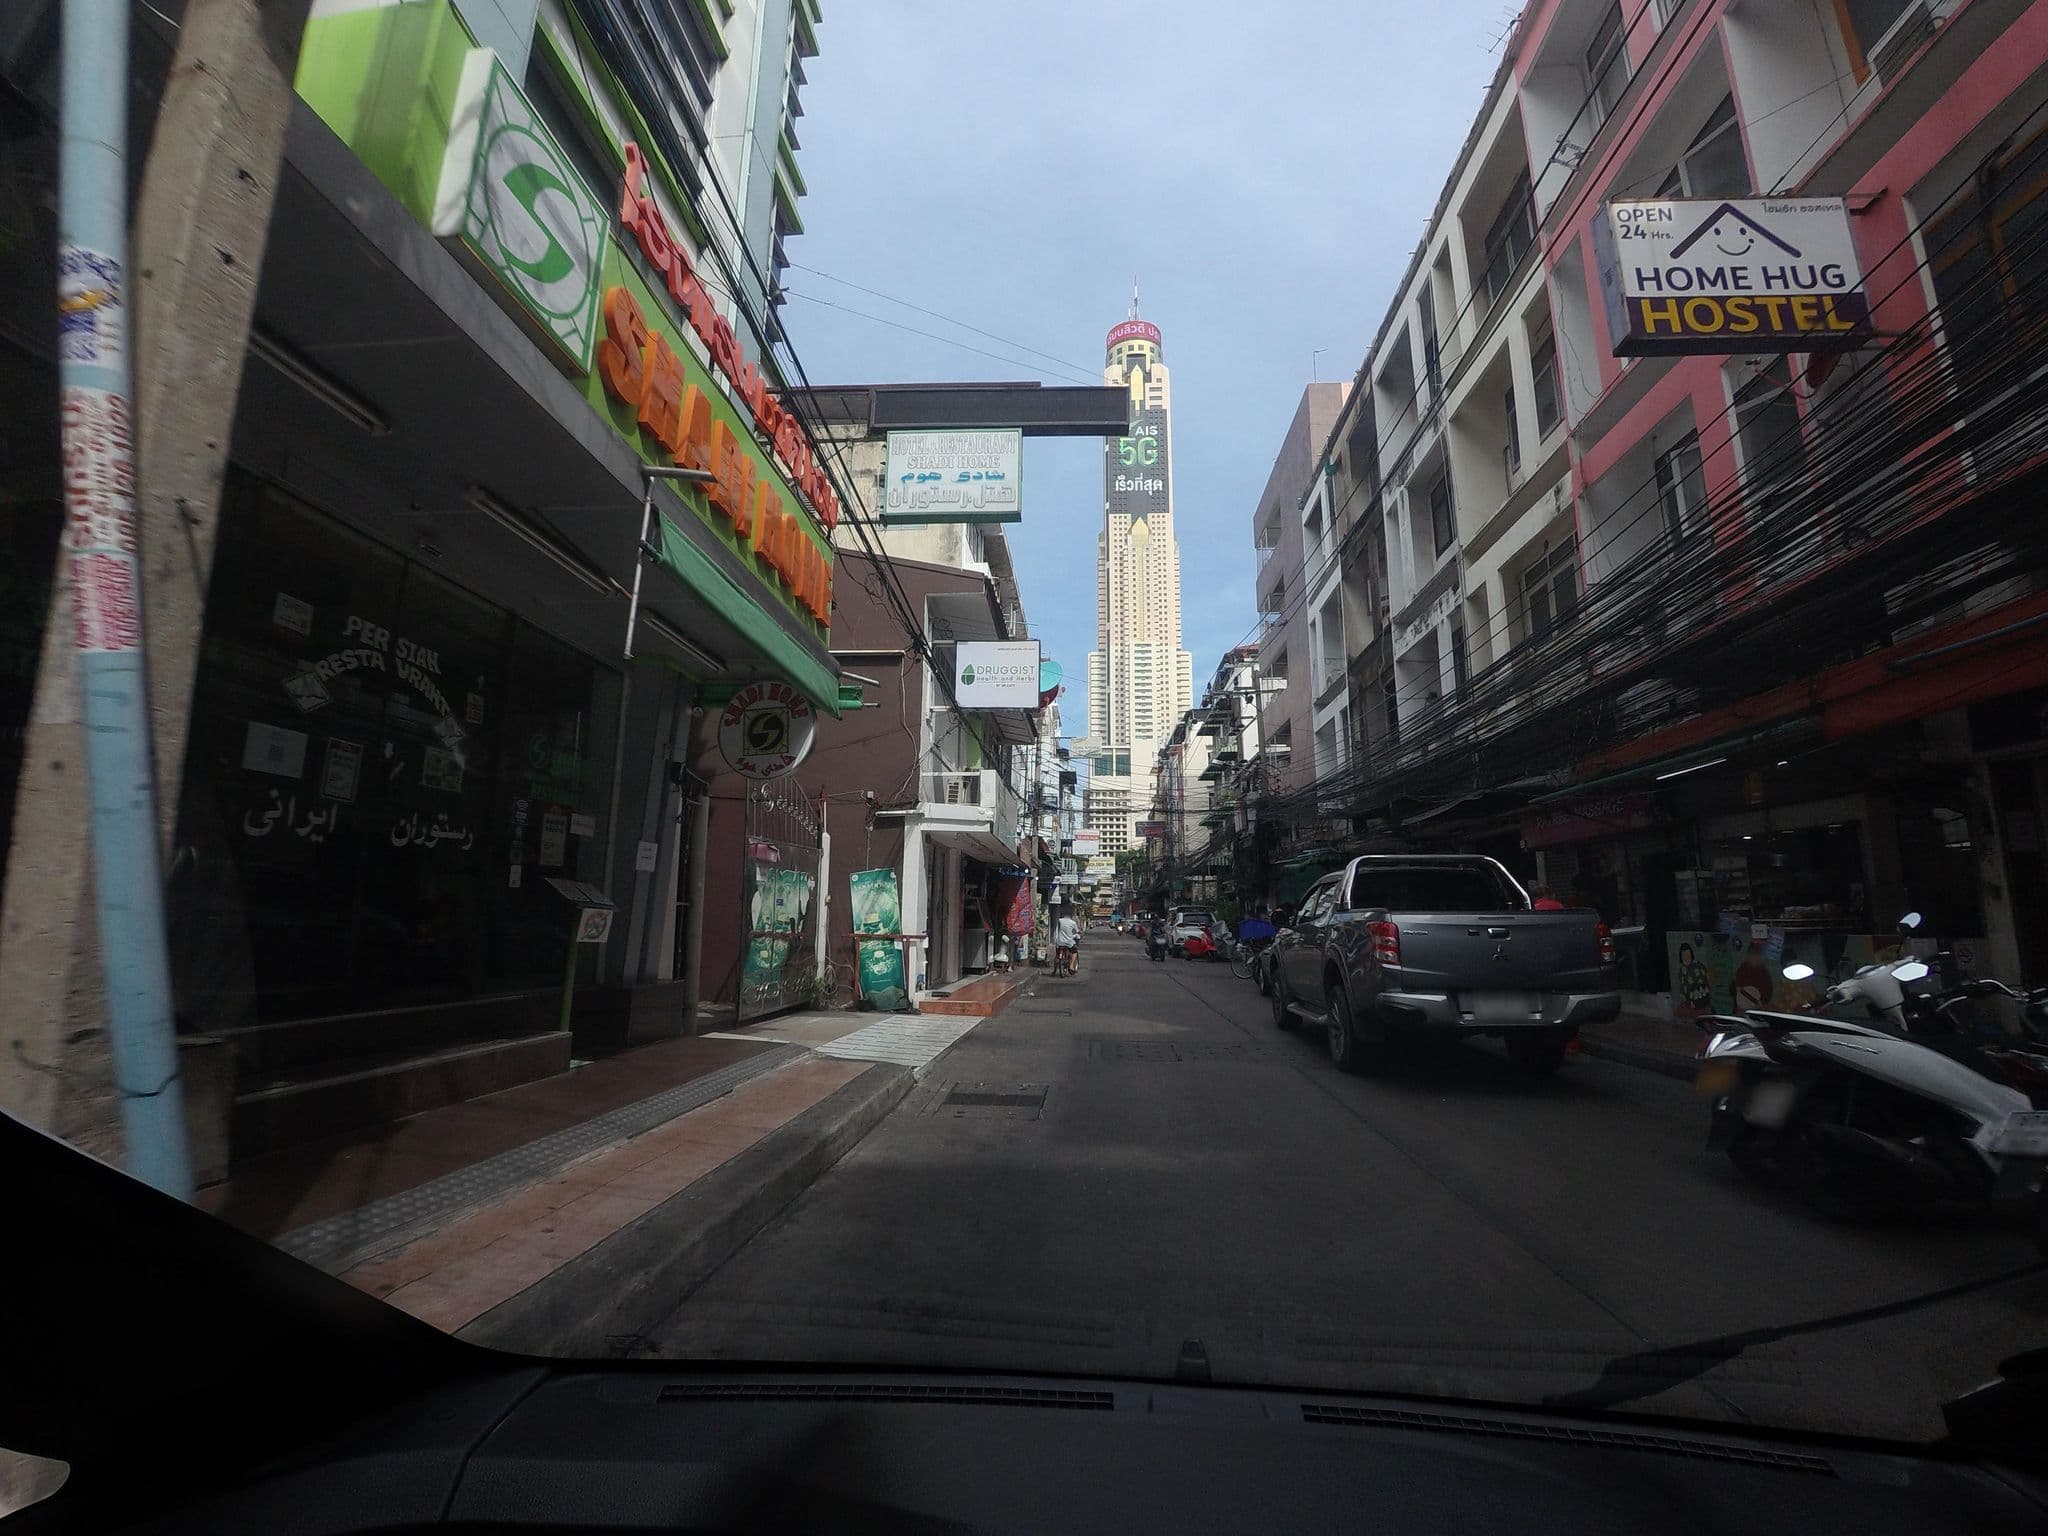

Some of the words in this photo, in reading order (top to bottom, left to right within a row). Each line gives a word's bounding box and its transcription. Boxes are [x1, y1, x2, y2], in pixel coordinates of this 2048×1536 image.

[1616, 207, 1673, 223] OPEN
[1620, 224, 1648, 240] 24
[1651, 231, 1674, 240] Hrs.
[1635, 267, 1755, 292] HOME
[1762, 263, 1847, 291] HUG
[1640, 296, 1856, 334] HOSTEL
[1135, 425, 1158, 436] AIS
[892, 436, 928, 455] HOTEL
[938, 434, 1016, 455] RESTAURANT
[1119, 436, 1159, 467] 5G
[907, 456, 954, 469] SHADI
[957, 455, 1001, 468] HOME
[1115, 472, 1163, 496] เร็วที่สุด
[343, 615, 391, 651] PER
[976, 665, 1035, 675] DRUGGIST
[391, 809, 474, 851] رستوران
